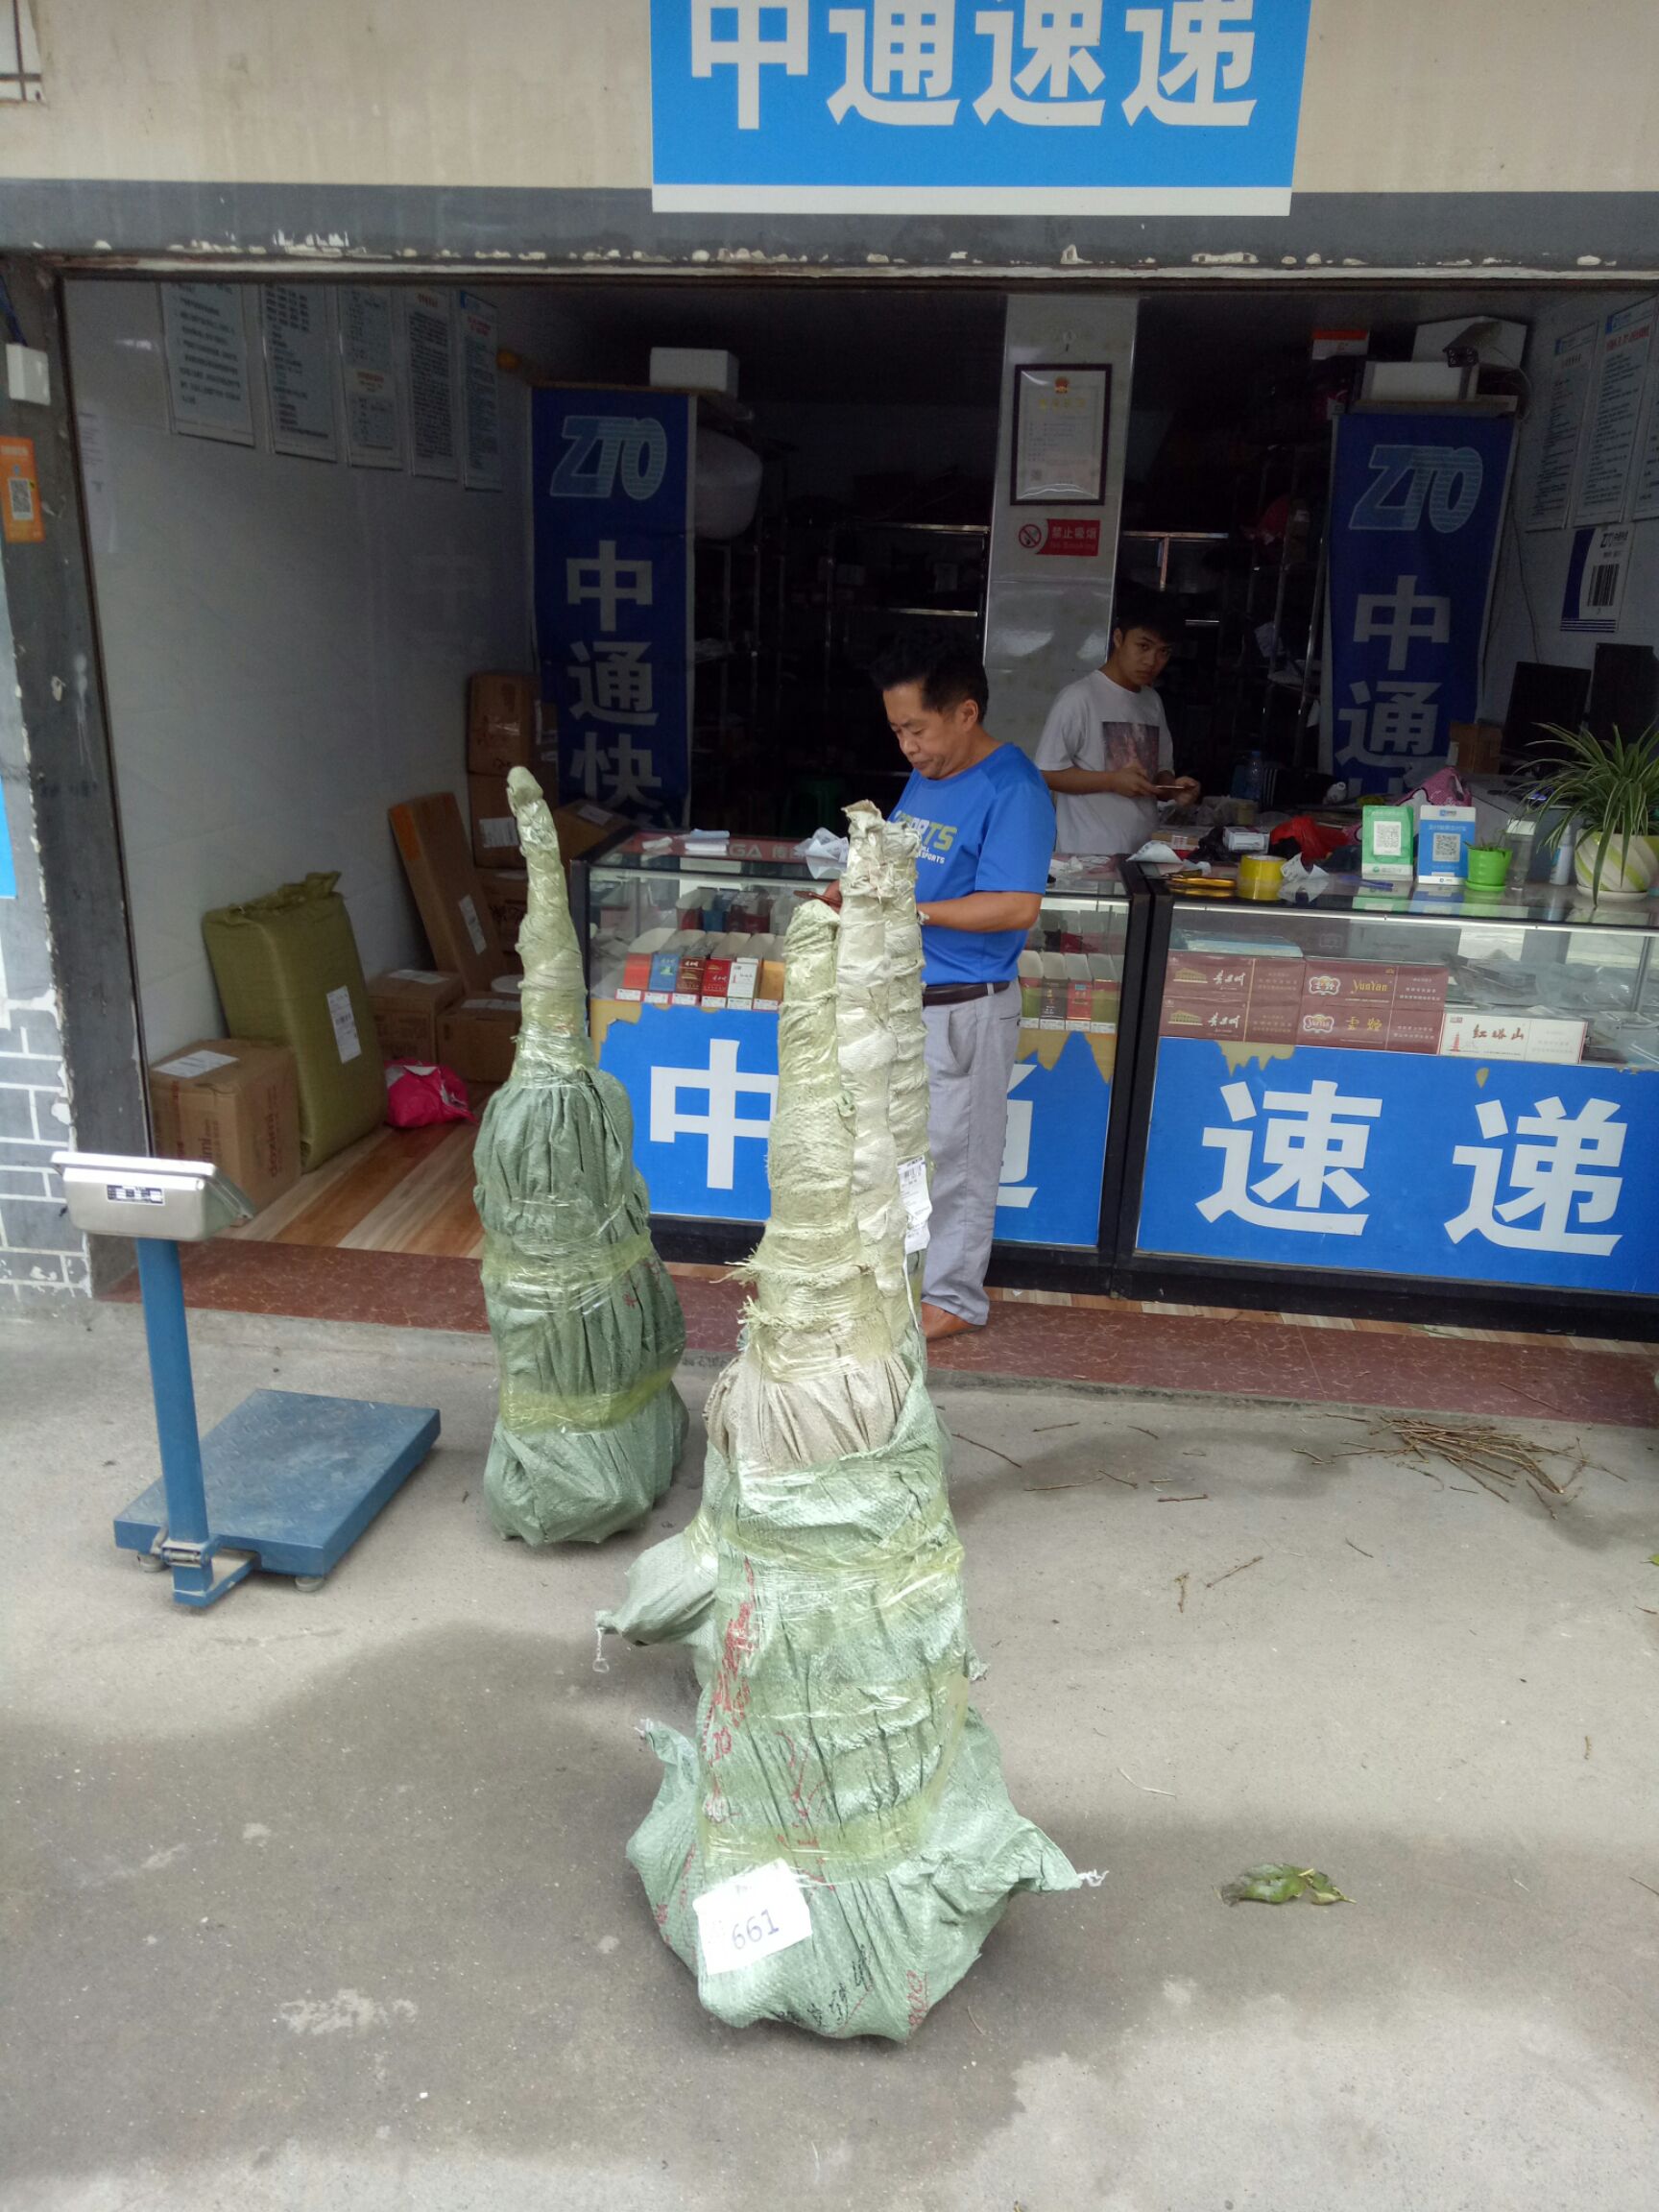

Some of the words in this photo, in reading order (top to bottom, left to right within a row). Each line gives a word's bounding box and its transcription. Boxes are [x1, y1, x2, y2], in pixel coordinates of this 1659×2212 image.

[686, 0, 1258, 130] 中通速递
[550, 415, 667, 500] ZTO
[1348, 444, 1483, 533] ZTO
[1334, 575, 1451, 795] 中通
[1472, 1023, 1525, 1041] 红塔山
[732, 1909, 780, 1950] 661
